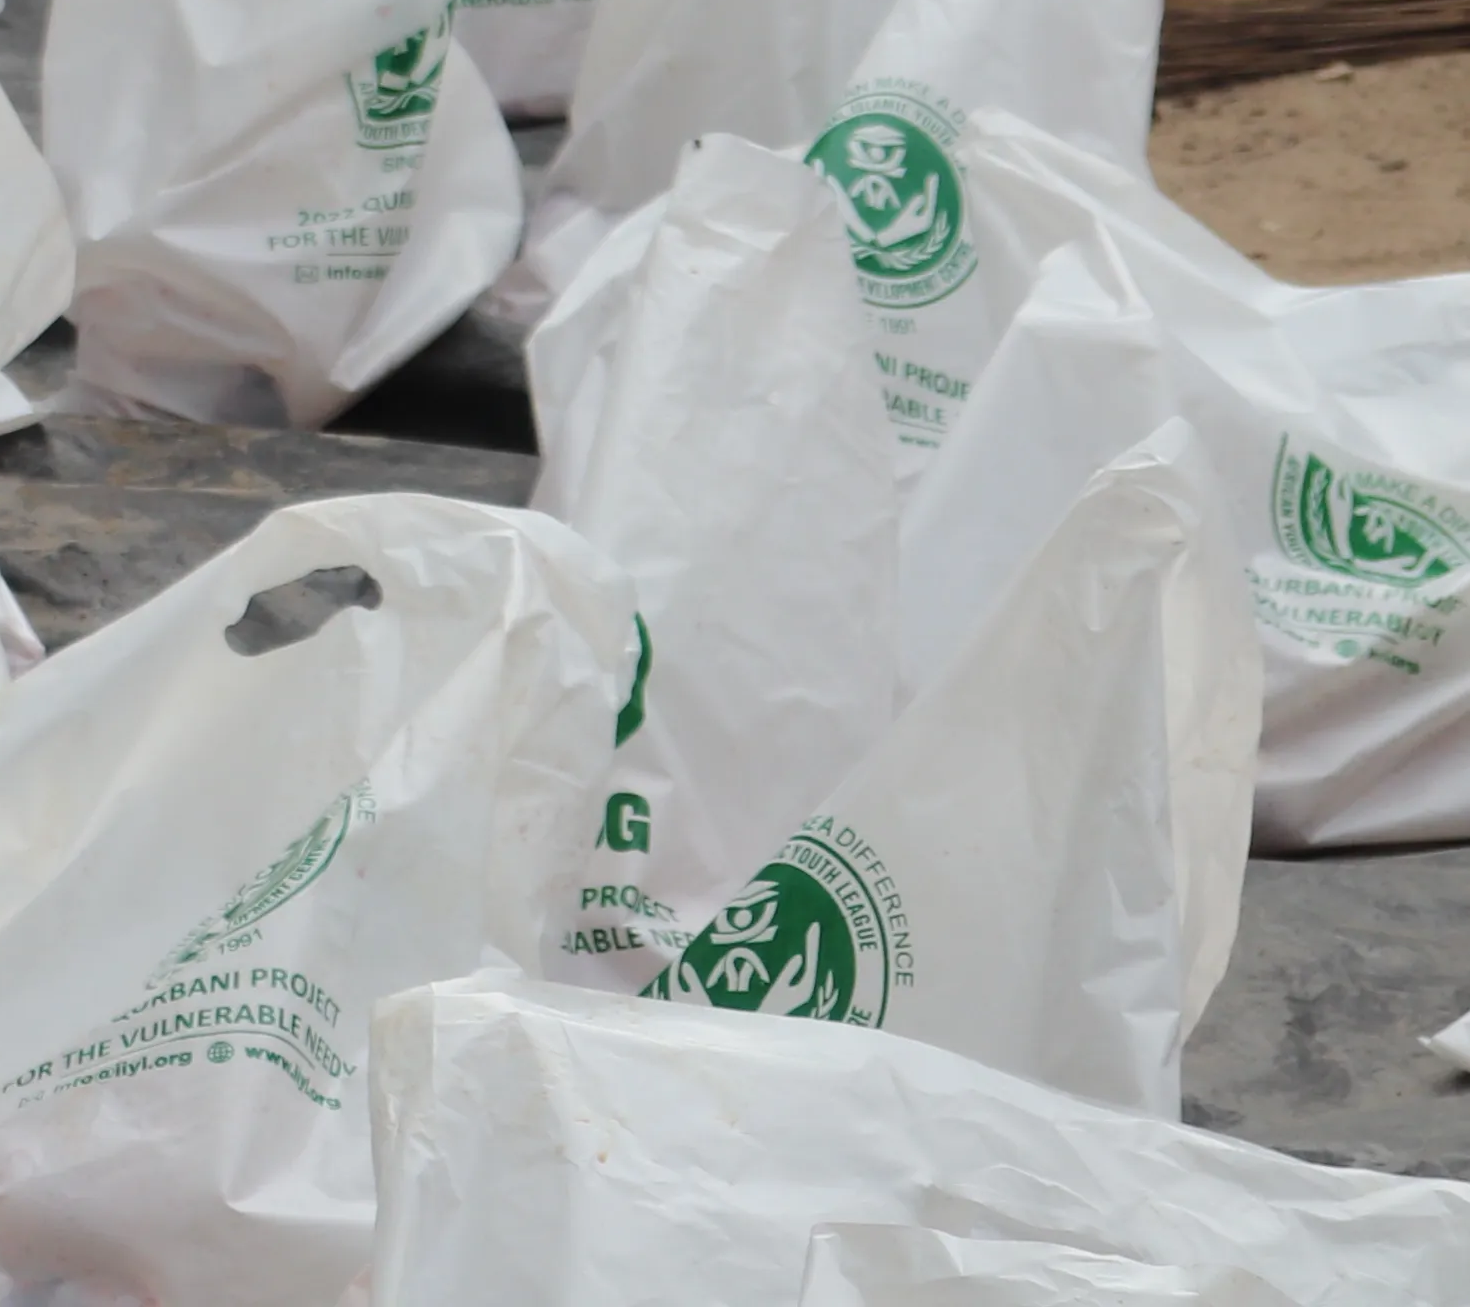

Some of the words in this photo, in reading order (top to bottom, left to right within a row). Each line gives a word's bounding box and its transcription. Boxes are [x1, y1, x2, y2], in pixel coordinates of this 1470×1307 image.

[326, 226, 371, 248] THE
[790, 843, 843, 886] YOUTH
[834, 880, 879, 953] LEAGUE
[819, 815, 836, 838] A
[834, 825, 915, 989] DIFFERENCE
[217, 927, 263, 956] 1991
[250, 968, 342, 1030] PROJECT
[63, 1040, 112, 1070] THE
[119, 1003, 302, 1051] VULNERABLE
[303, 1024, 357, 1078] NEEDY
